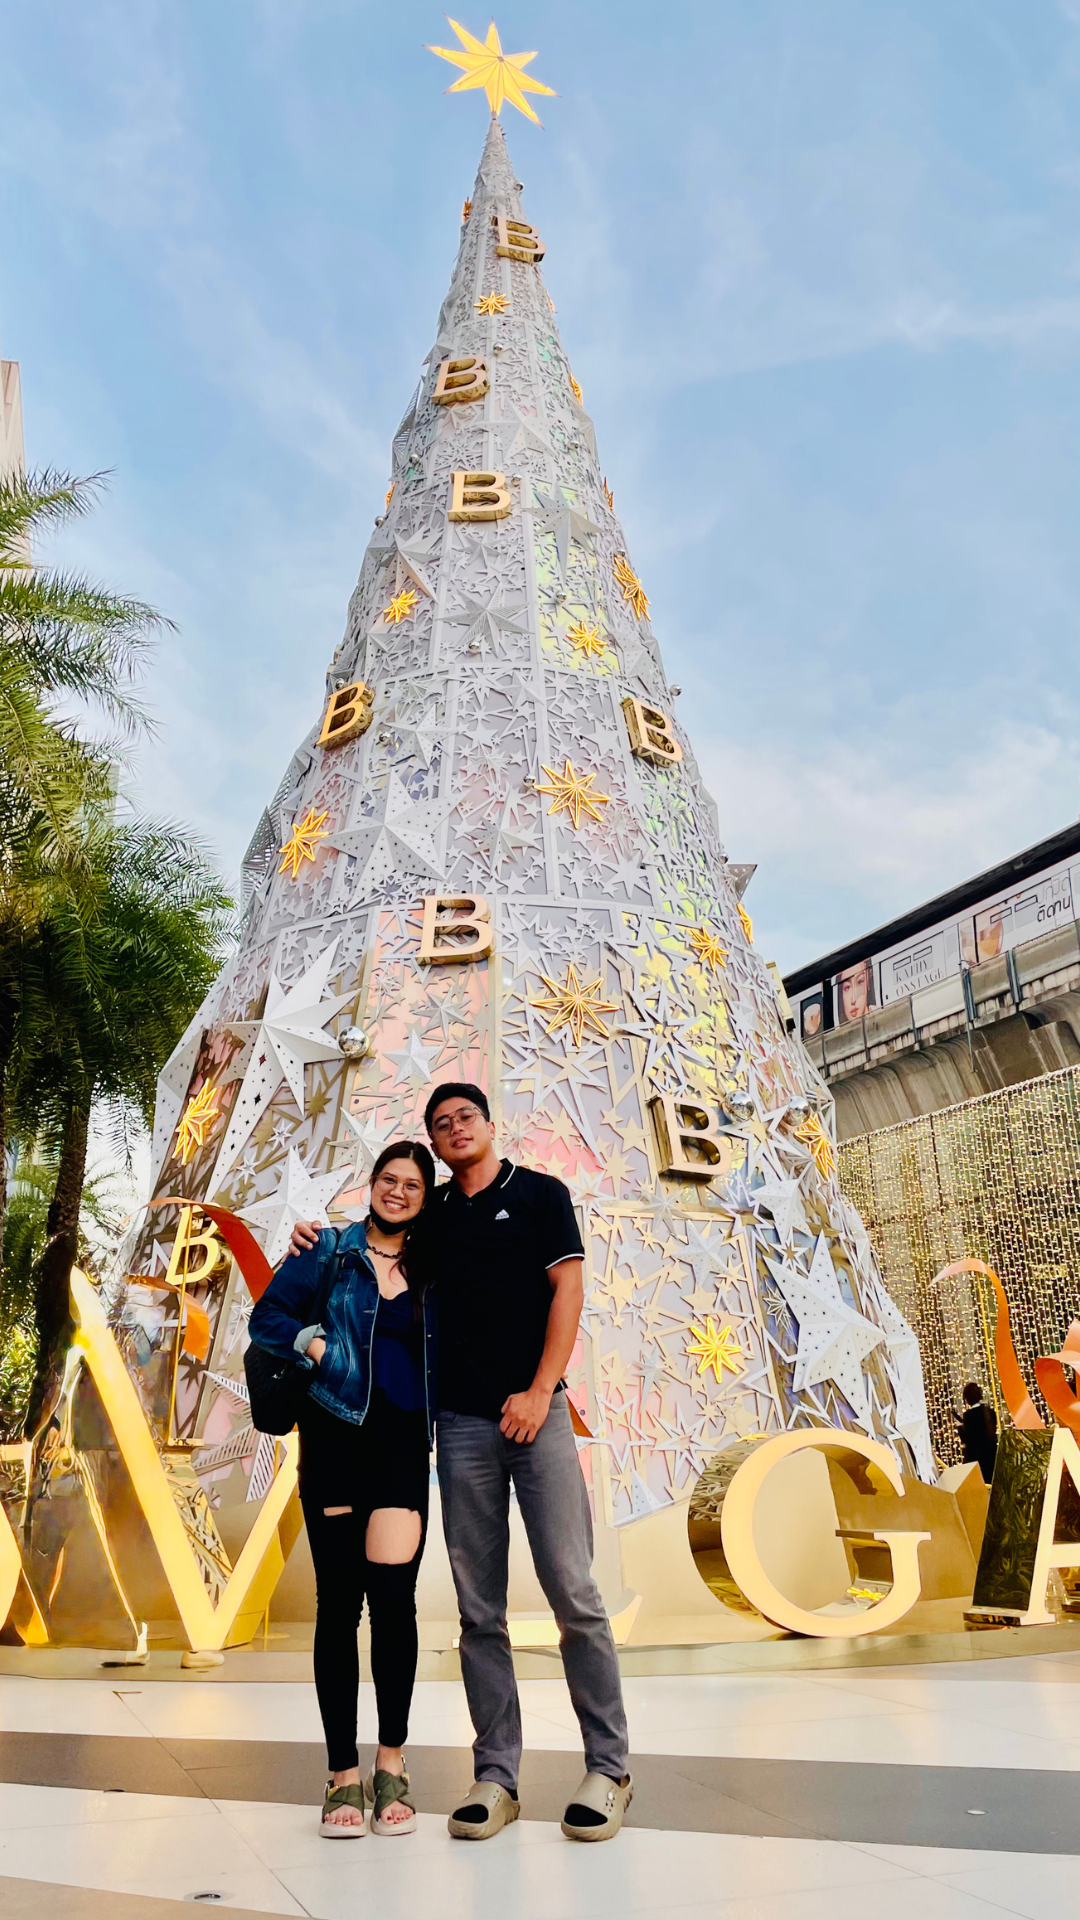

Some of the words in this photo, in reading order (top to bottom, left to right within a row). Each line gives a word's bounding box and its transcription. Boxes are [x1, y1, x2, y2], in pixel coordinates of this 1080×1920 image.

[493, 215, 547, 259] B
[431, 355, 489, 403] B
[447, 471, 512, 516] B
[316, 681, 371, 748] B
[622, 697, 683, 765] B
[415, 893, 495, 961] B
[895, 967, 945, 997] ONSTAGE
[646, 1094, 731, 1178] B
[165, 1202, 221, 1286] B
